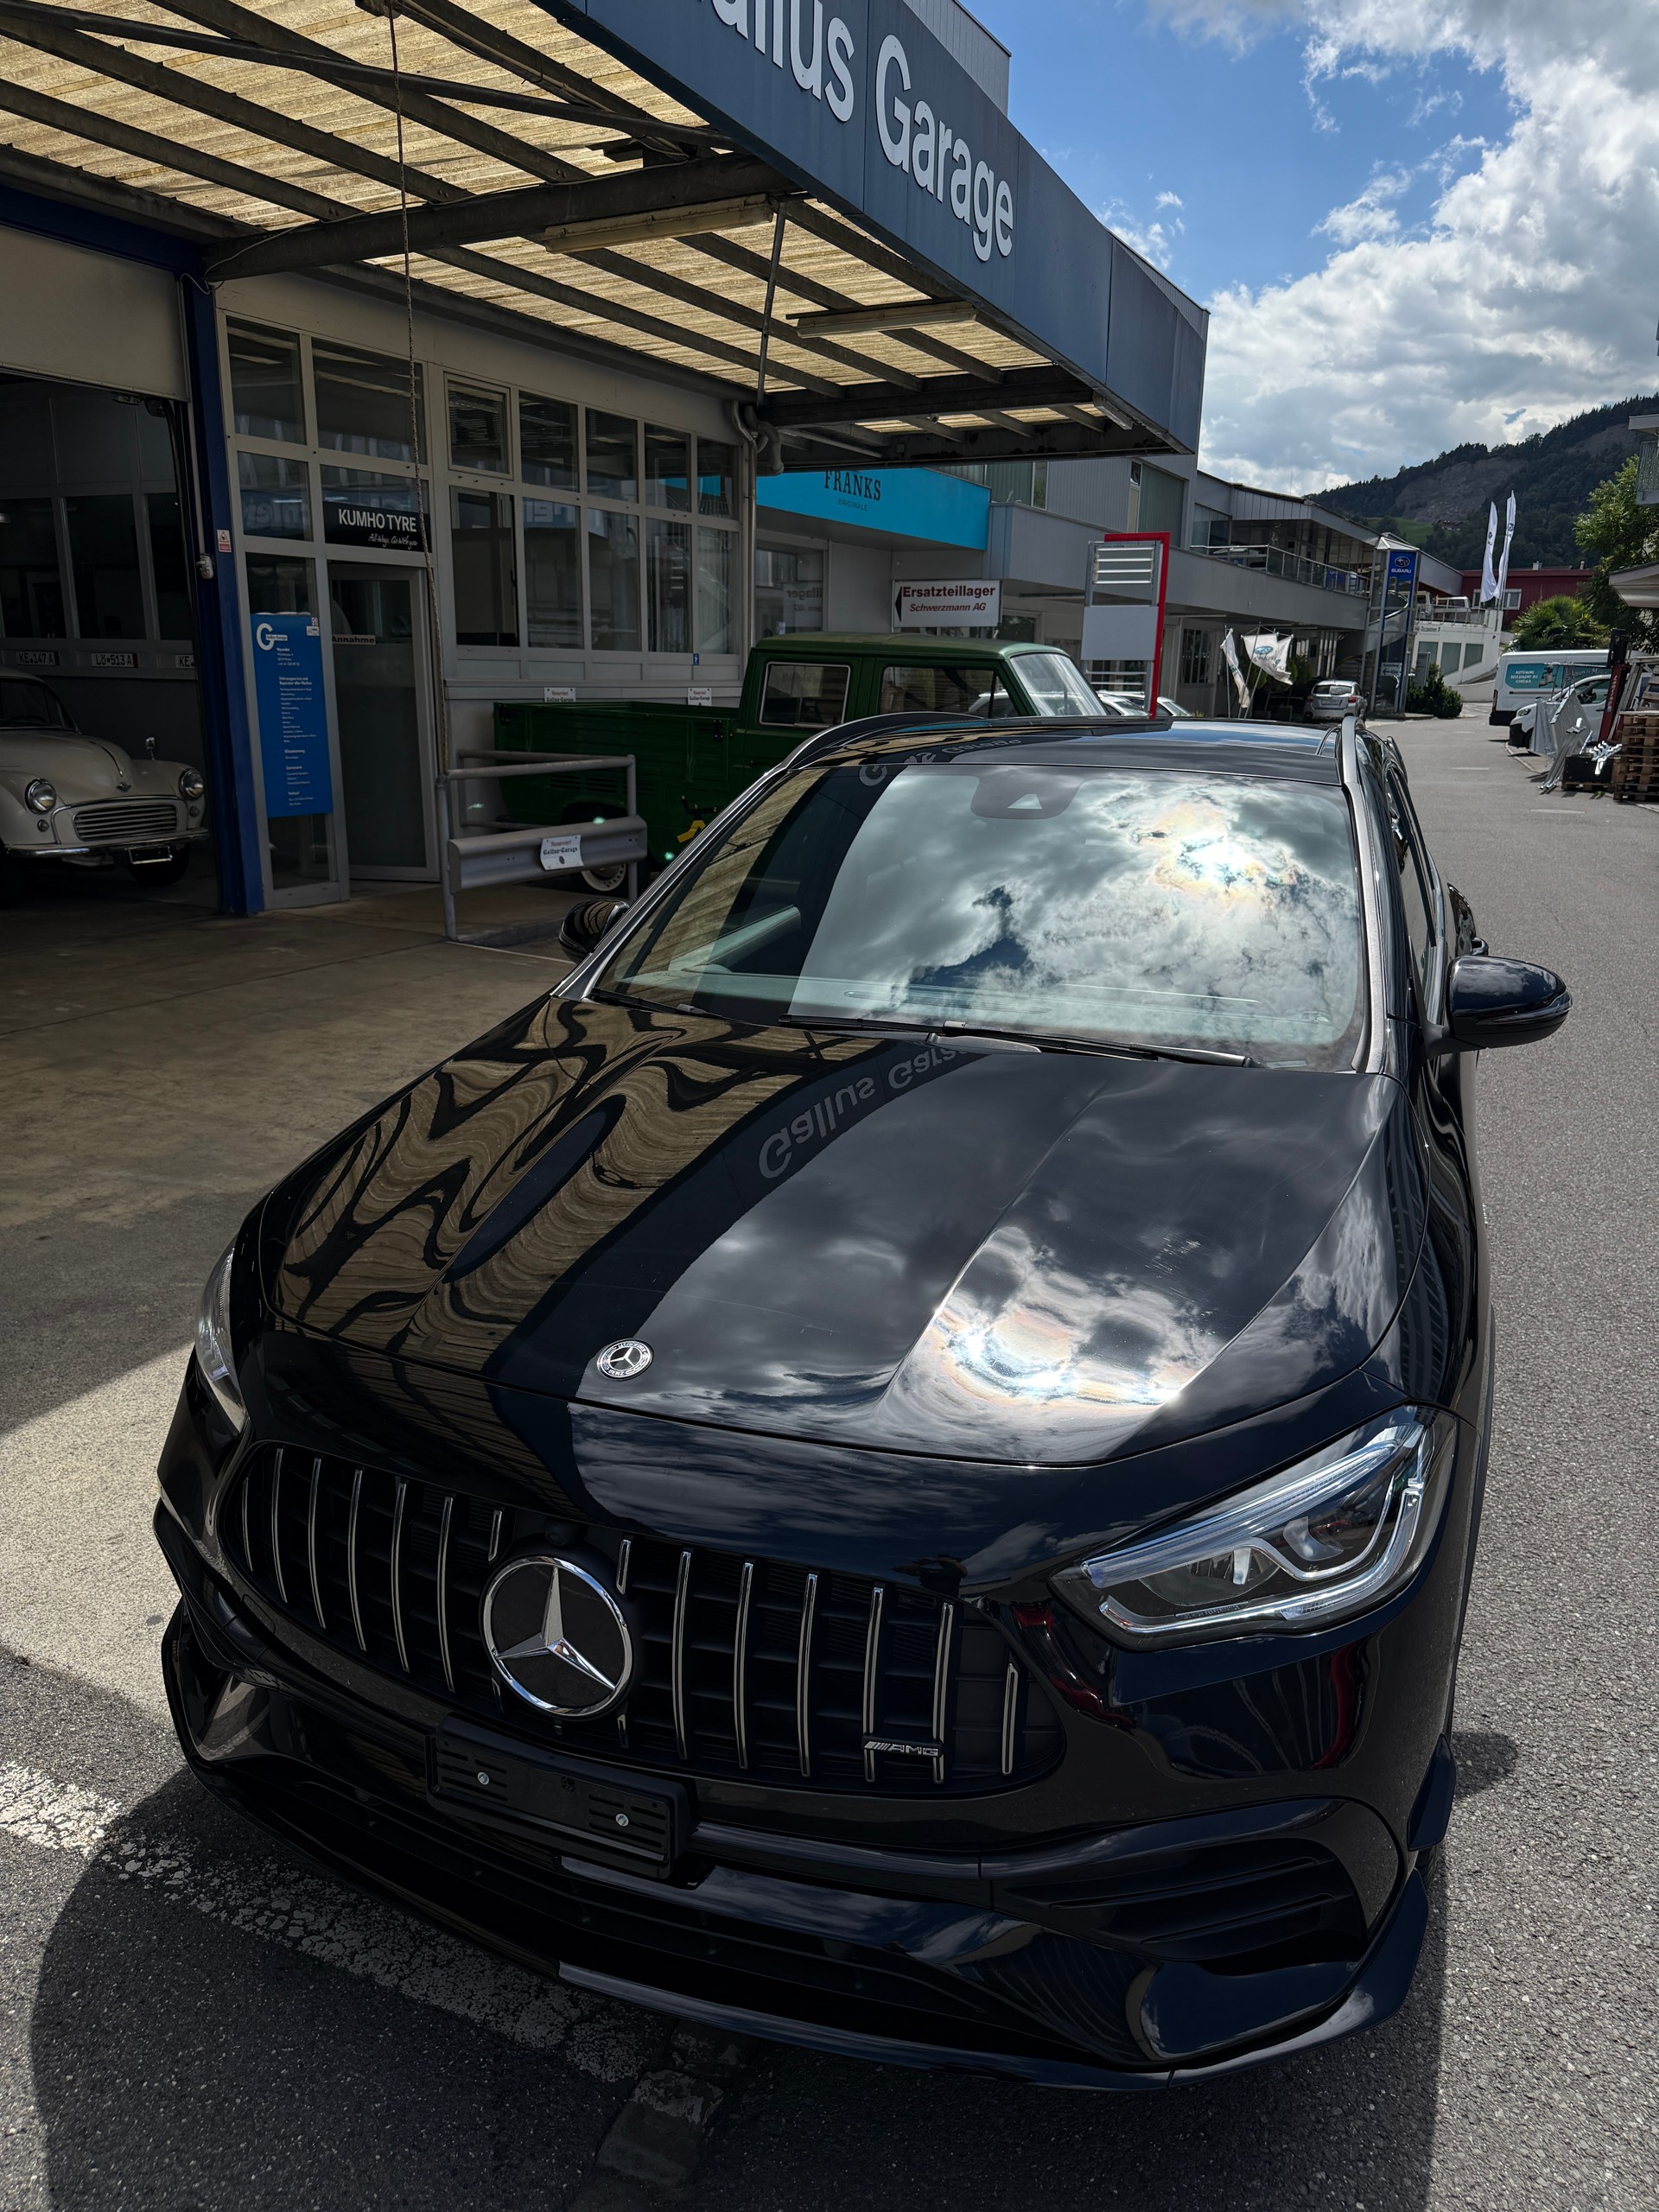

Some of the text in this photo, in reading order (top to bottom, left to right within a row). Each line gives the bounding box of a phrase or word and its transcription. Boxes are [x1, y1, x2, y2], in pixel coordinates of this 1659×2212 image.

[875, 35, 1014, 261] Garage
[824, 470, 880, 501] FRANKS
[837, 499, 868, 512] ORIGINALE
[338, 508, 417, 532] KUMHO TYRE
[903, 586, 995, 599] Ersatzteillager
[910, 602, 986, 612] Schwerzmann AG
[332, 635, 375, 644] Annahme
[887, 1744, 938, 1757] AMG
